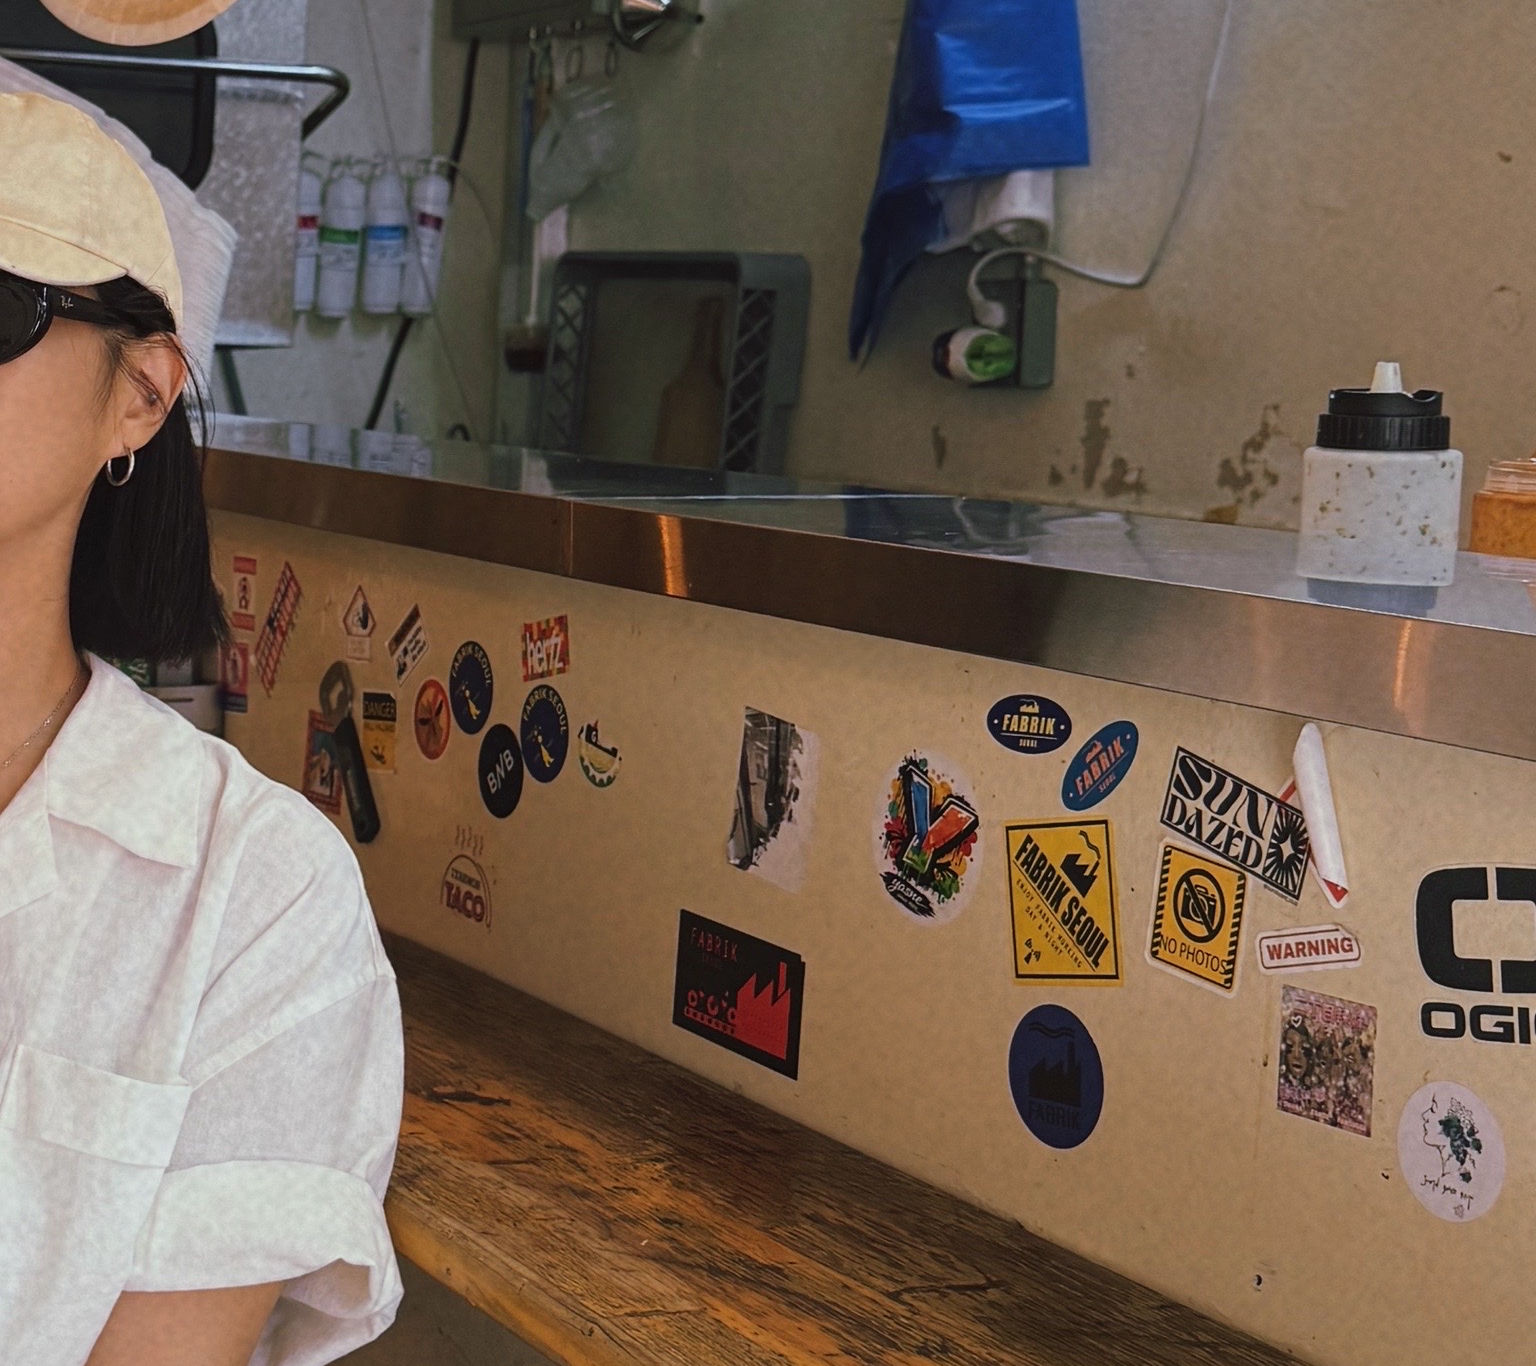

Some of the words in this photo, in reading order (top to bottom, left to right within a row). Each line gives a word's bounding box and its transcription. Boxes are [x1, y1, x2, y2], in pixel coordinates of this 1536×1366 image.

[363, 699, 396, 720] DANGER
[522, 687, 547, 722] FABRIK
[547, 689, 569, 735] SEOUL
[1001, 713, 1057, 736] FABRIK
[1074, 735, 1125, 796] FABRIK
[1172, 754, 1274, 840] SUN
[1164, 792, 1264, 869] DAZED
[444, 880, 485, 923] TACO
[1014, 833, 1071, 914] FABRIK
[1060, 895, 1110, 969] SEOUL
[1024, 905, 1038, 922] DAY
[688, 926, 738, 963] FABRIK
[1158, 934, 1178, 955] NO
[1178, 942, 1228, 976] PHOTOS
[1266, 936, 1354, 961] WARNING
[1421, 1002, 1536, 1045] OGI
